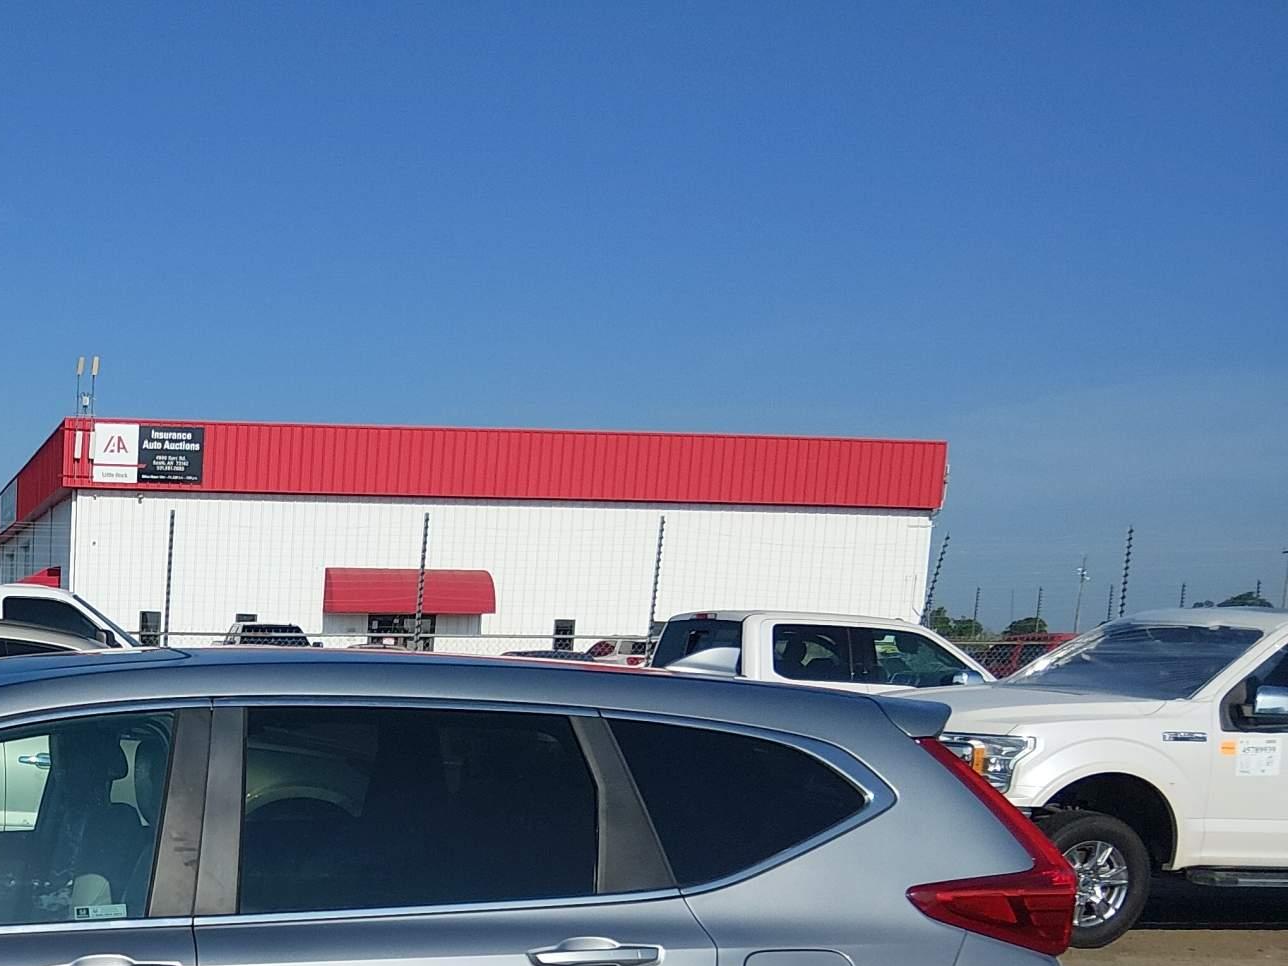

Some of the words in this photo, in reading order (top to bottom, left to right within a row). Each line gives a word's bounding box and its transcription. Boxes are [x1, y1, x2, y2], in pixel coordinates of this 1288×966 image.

[151, 429, 192, 440] Insurance
[142, 439, 162, 450] Auto
[163, 440, 200, 451] Auctions
